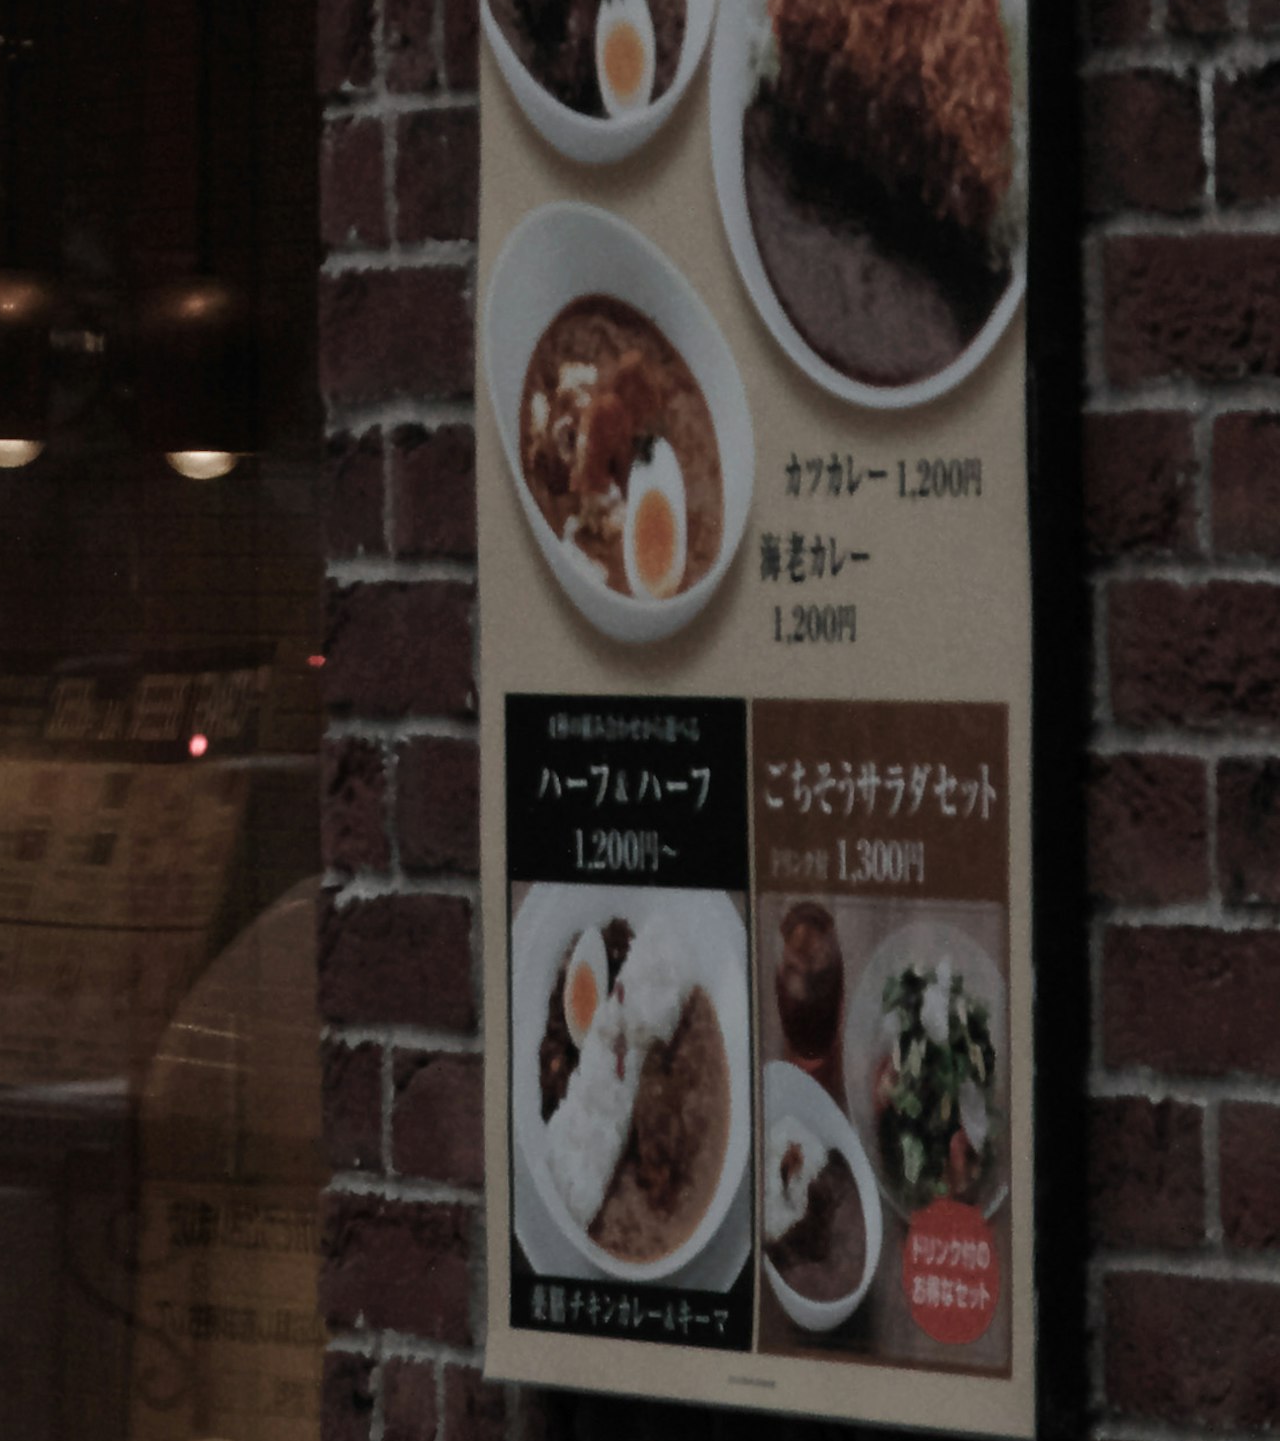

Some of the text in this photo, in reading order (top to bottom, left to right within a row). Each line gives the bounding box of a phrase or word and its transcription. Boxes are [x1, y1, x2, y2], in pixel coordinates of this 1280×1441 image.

[785, 451, 887, 497] カツカレー
[759, 533, 870, 584] 海老カレー
[763, 758, 997, 821] ごちそうサラダセット
